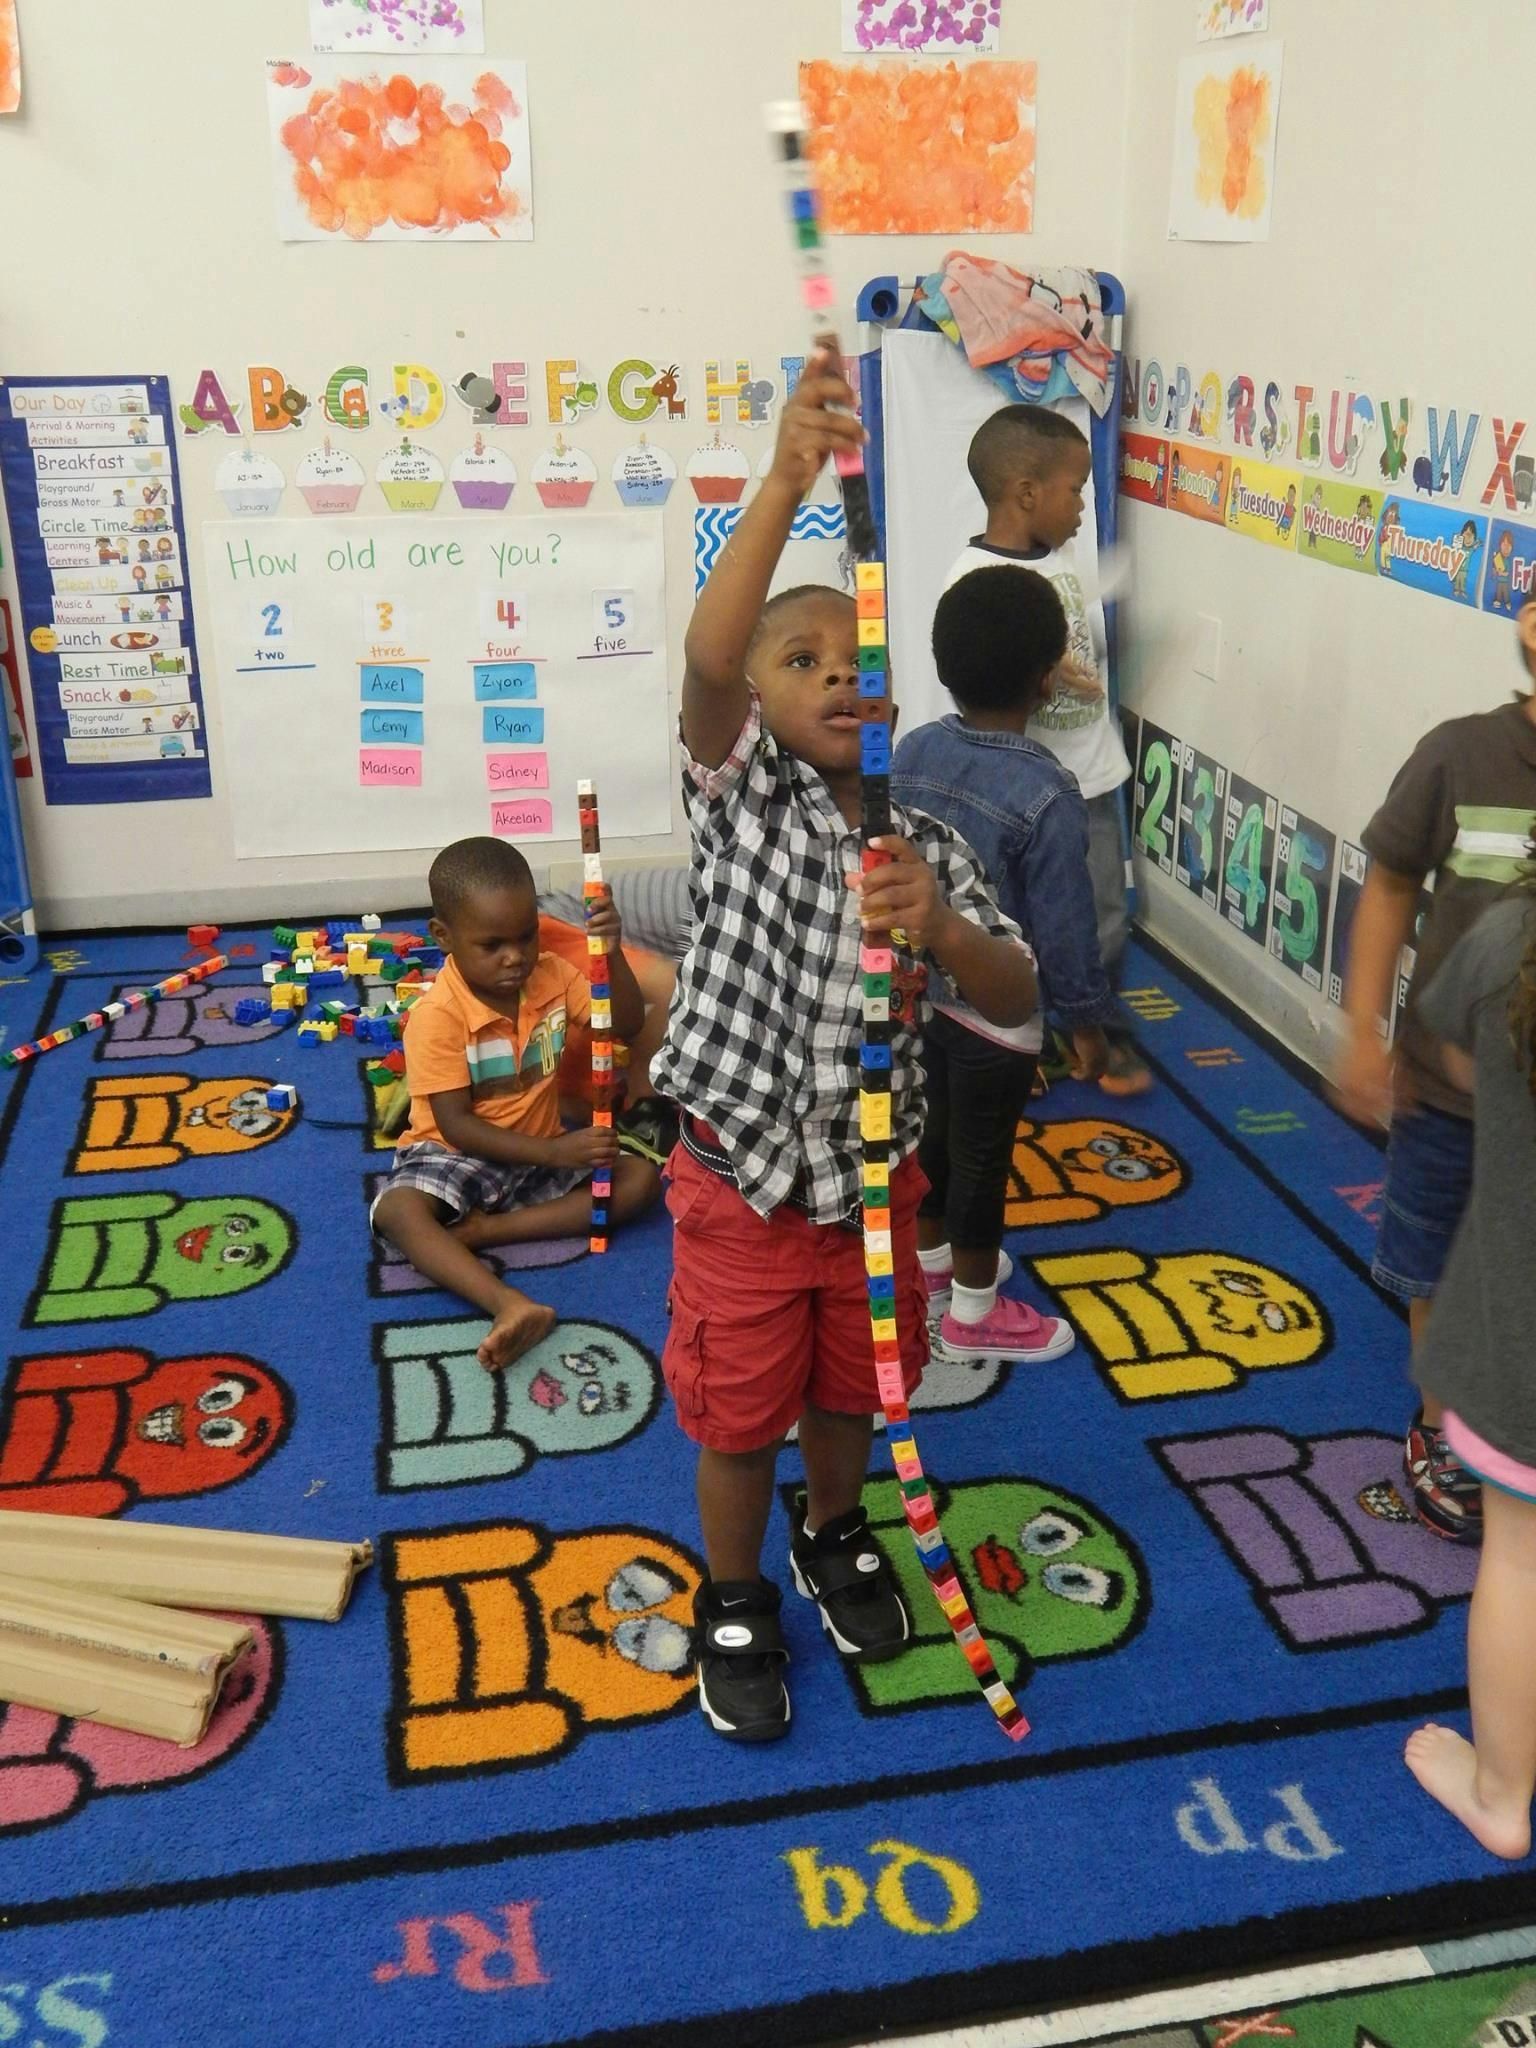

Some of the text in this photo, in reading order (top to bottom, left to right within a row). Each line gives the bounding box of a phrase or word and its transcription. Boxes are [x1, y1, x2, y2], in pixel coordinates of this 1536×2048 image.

[13, 394, 87, 413] Our Day
[185, 370, 241, 434] A
[248, 367, 290, 432] B
[325, 366, 370, 430] C
[394, 364, 444, 430] D
[492, 362, 528, 425] E
[546, 360, 577, 423] F
[607, 359, 660, 422] G
[705, 360, 751, 423] H
[28, 420, 115, 432] Arrival & Morning
[30, 436, 79, 446] Activities
[1143, 360, 1164, 424] O
[1172, 366, 1192, 431] P
[1200, 371, 1222, 440] Q
[1233, 375, 1256, 446] R
[1261, 381, 1280, 454] S
[1295, 385, 1314, 461] T
[1327, 389, 1357, 470] U
[1380, 398, 1409, 481] V
[1427, 407, 1480, 496] W
[1480, 418, 1527, 511] X
[37, 453, 125, 471] Breakfast
[38, 482, 95, 495] Playground/
[40, 497, 102, 507] Gross Motor
[40, 518, 129, 533] Circle Time
[1178, 464, 1217, 505] Monday
[1238, 486, 1287, 525] Tuesday
[1303, 505, 1375, 554] Wednesday
[1388, 526, 1466, 580] Thursday
[46, 540, 91, 553] Learning
[48, 556, 90, 567] Centers
[227, 533, 562, 580] How old are you?
[55, 577, 119, 593] Clean Up
[54, 600, 93, 609] Music &
[56, 614, 107, 624] Movement
[260, 598, 627, 637] 2 3 4 5
[254, 635, 627, 661] two three four five
[63, 662, 149, 679] Rest Time
[371, 677, 405, 693] Axel
[481, 674, 523, 692] Ziyon
[63, 687, 113, 703] Snack
[69, 712, 124, 724] Playground/
[494, 715, 533, 736] Ryan
[71, 726, 130, 735] Gross Motor
[361, 761, 416, 776] Madison
[489, 762, 539, 782] Sidney
[495, 811, 543, 826] Akeelah
[1140, 740, 1327, 962] 2 3 4 5
[1175, 1776, 1346, 1863] Pp
[371, 1900, 552, 1993] Rr
